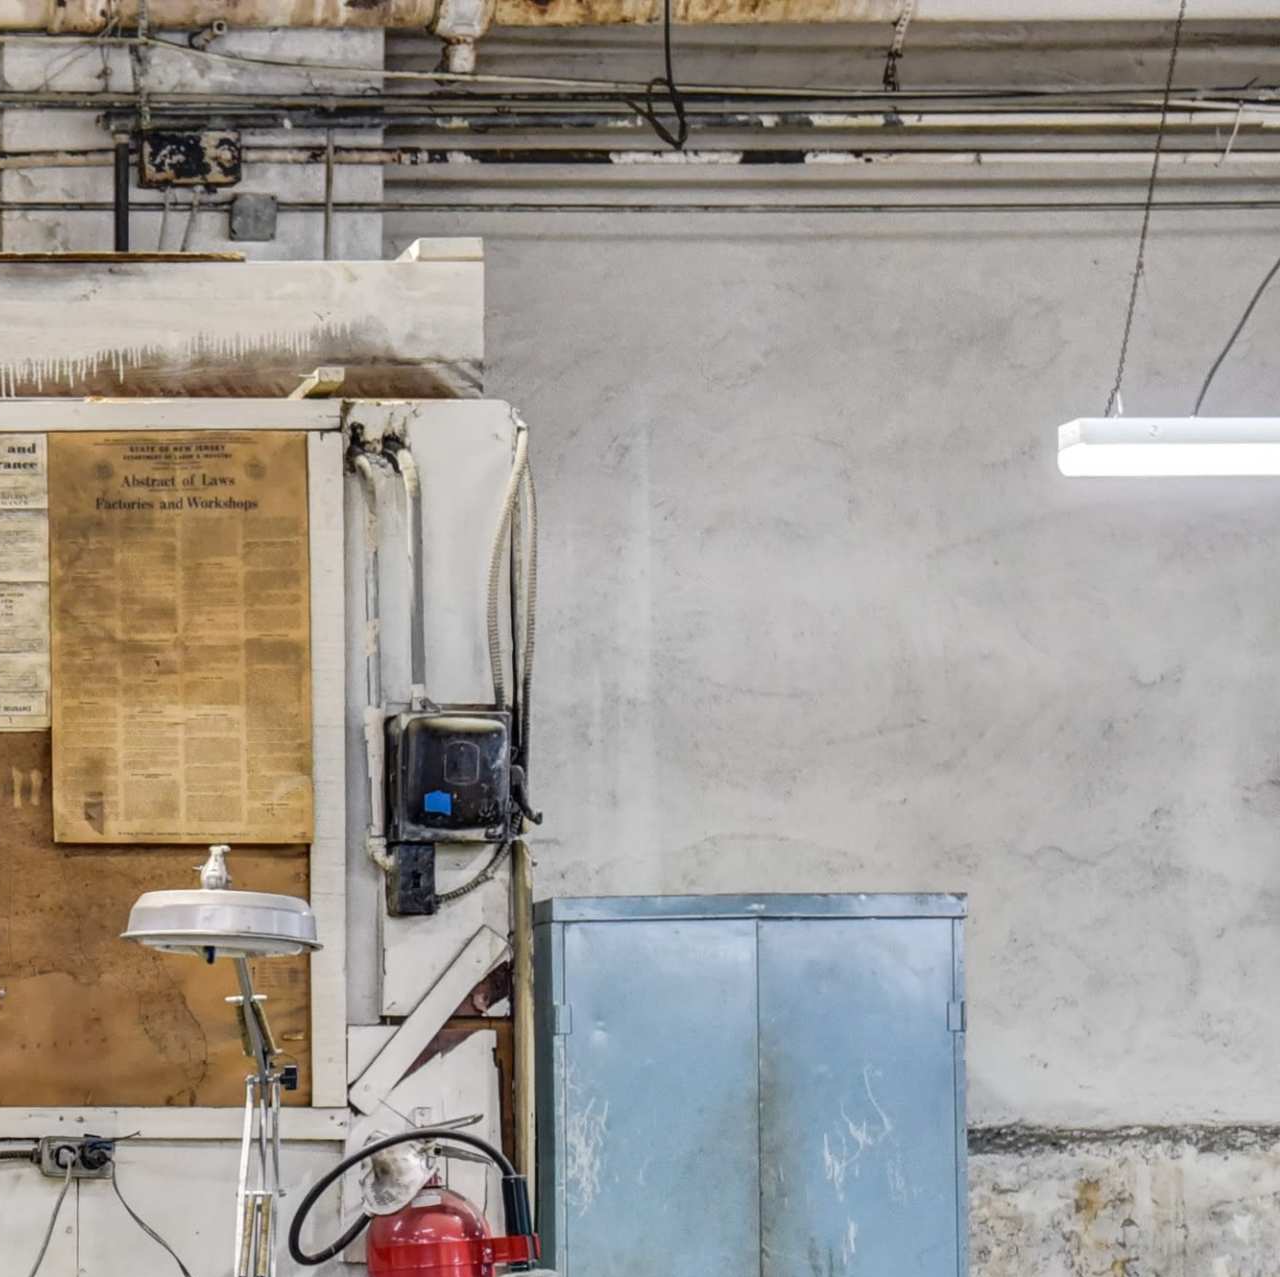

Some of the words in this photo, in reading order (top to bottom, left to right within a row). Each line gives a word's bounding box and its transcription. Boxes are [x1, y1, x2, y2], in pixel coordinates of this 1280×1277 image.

[7, 443, 37, 455] and
[121, 474, 176, 488] Abstract
[182, 473, 196, 487] of
[201, 473, 236, 488] Laws
[95, 496, 154, 511] Factories
[159, 496, 184, 510] and
[186, 495, 259, 512] Workshops
